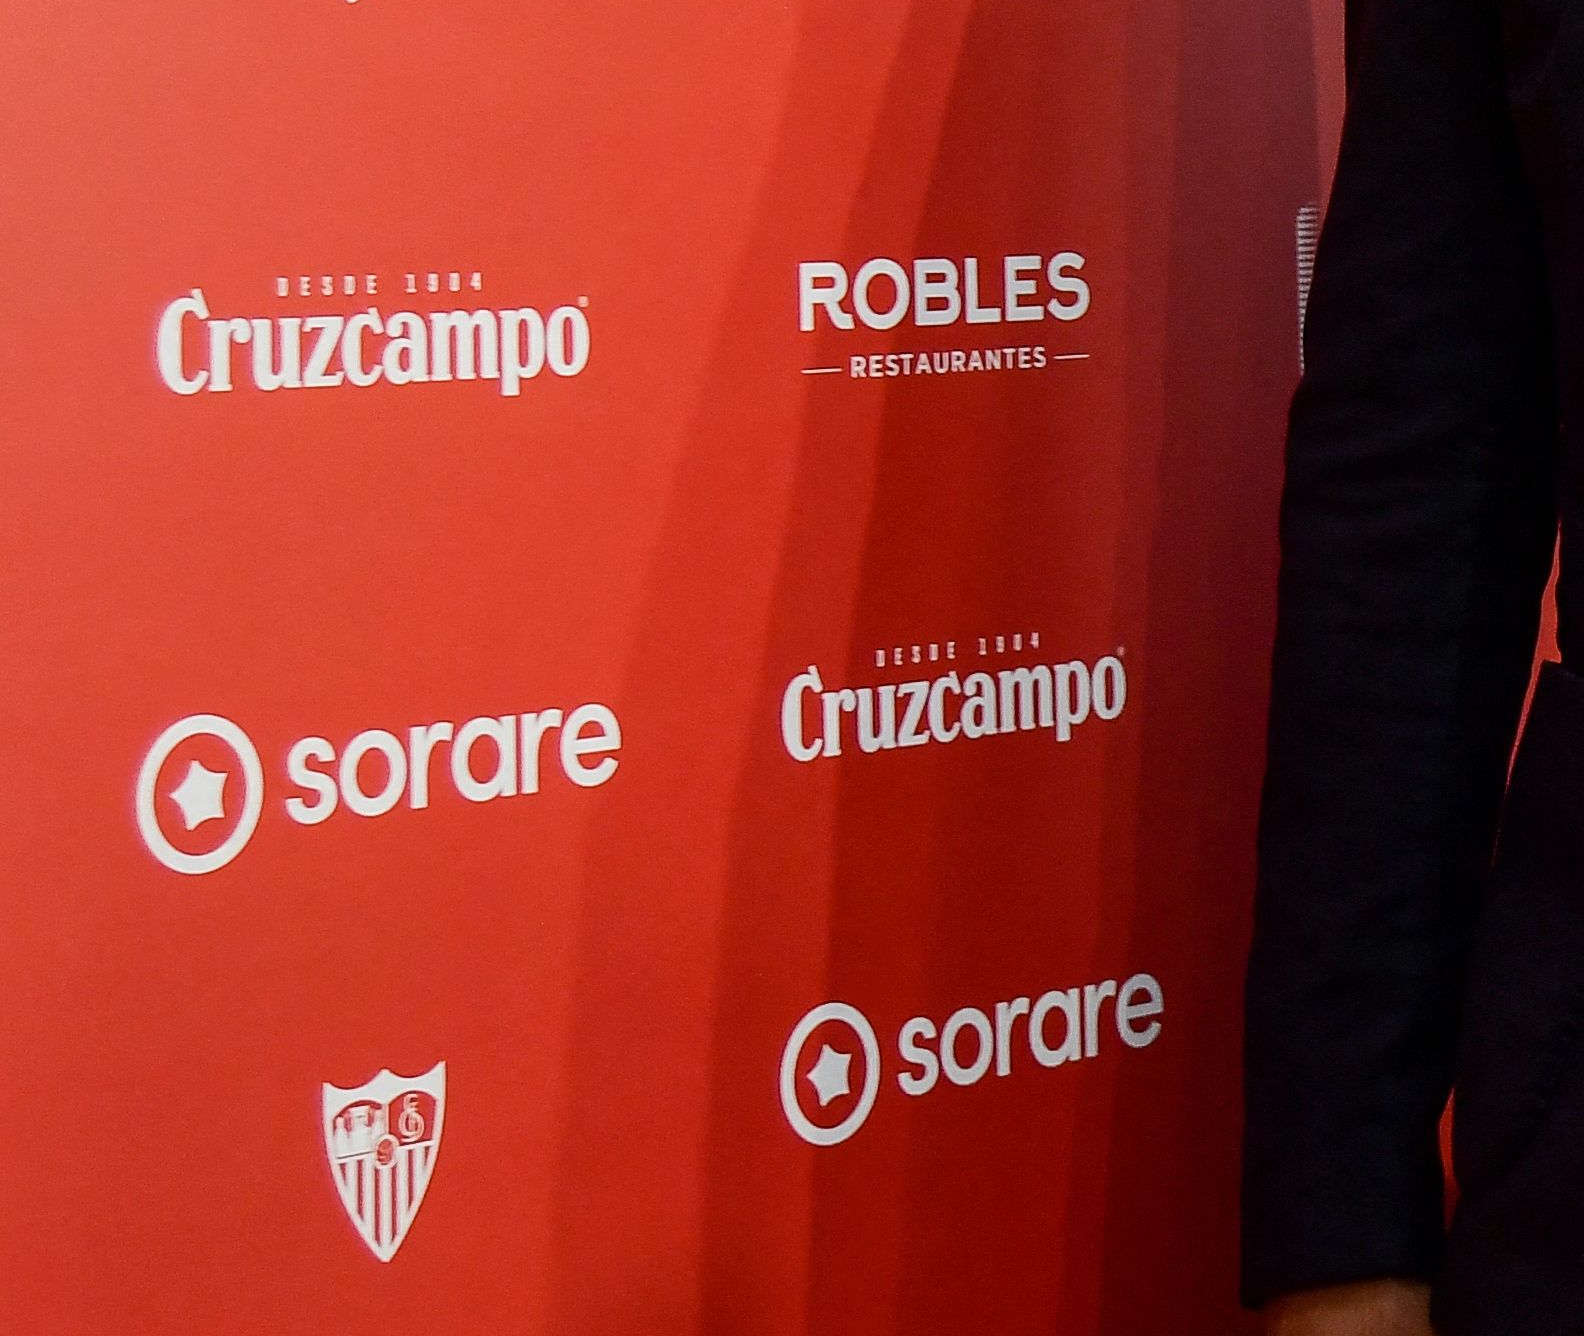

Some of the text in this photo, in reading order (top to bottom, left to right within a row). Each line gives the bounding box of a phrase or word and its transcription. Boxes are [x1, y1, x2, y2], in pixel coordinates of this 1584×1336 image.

[156, 284, 592, 397] Cruzcampo
[276, 274, 378, 298] DESDE
[798, 252, 1091, 333] ROBLES
[849, 346, 1047, 380] RESTAURANTES
[780, 654, 1128, 763] Cruzcampo
[284, 701, 623, 827] sorare
[897, 972, 1166, 1097] sorare
